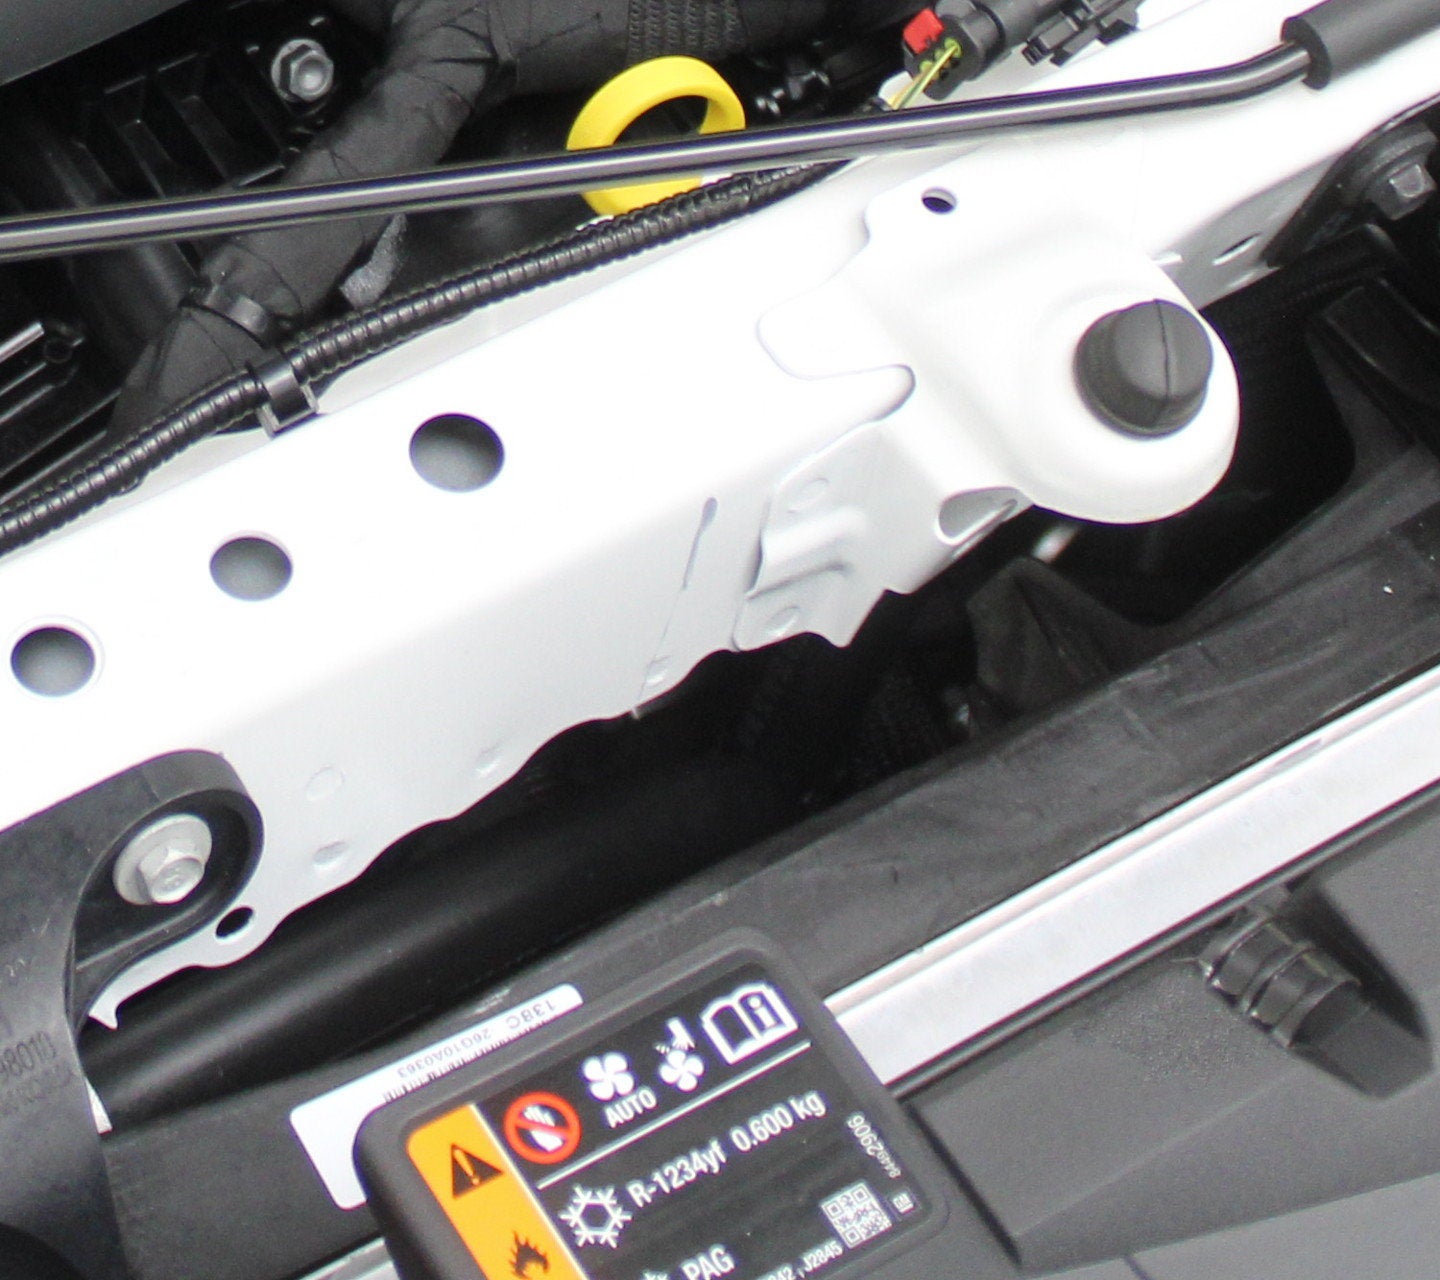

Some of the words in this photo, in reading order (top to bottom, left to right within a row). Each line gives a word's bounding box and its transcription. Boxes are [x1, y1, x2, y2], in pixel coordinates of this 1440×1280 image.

[603, 1086, 658, 1129] AUTO
[625, 1137, 727, 1208] R-1234yf
[729, 1104, 794, 1152] 0.600
[789, 1090, 827, 1120] kg
[680, 1244, 736, 1280] PAG
